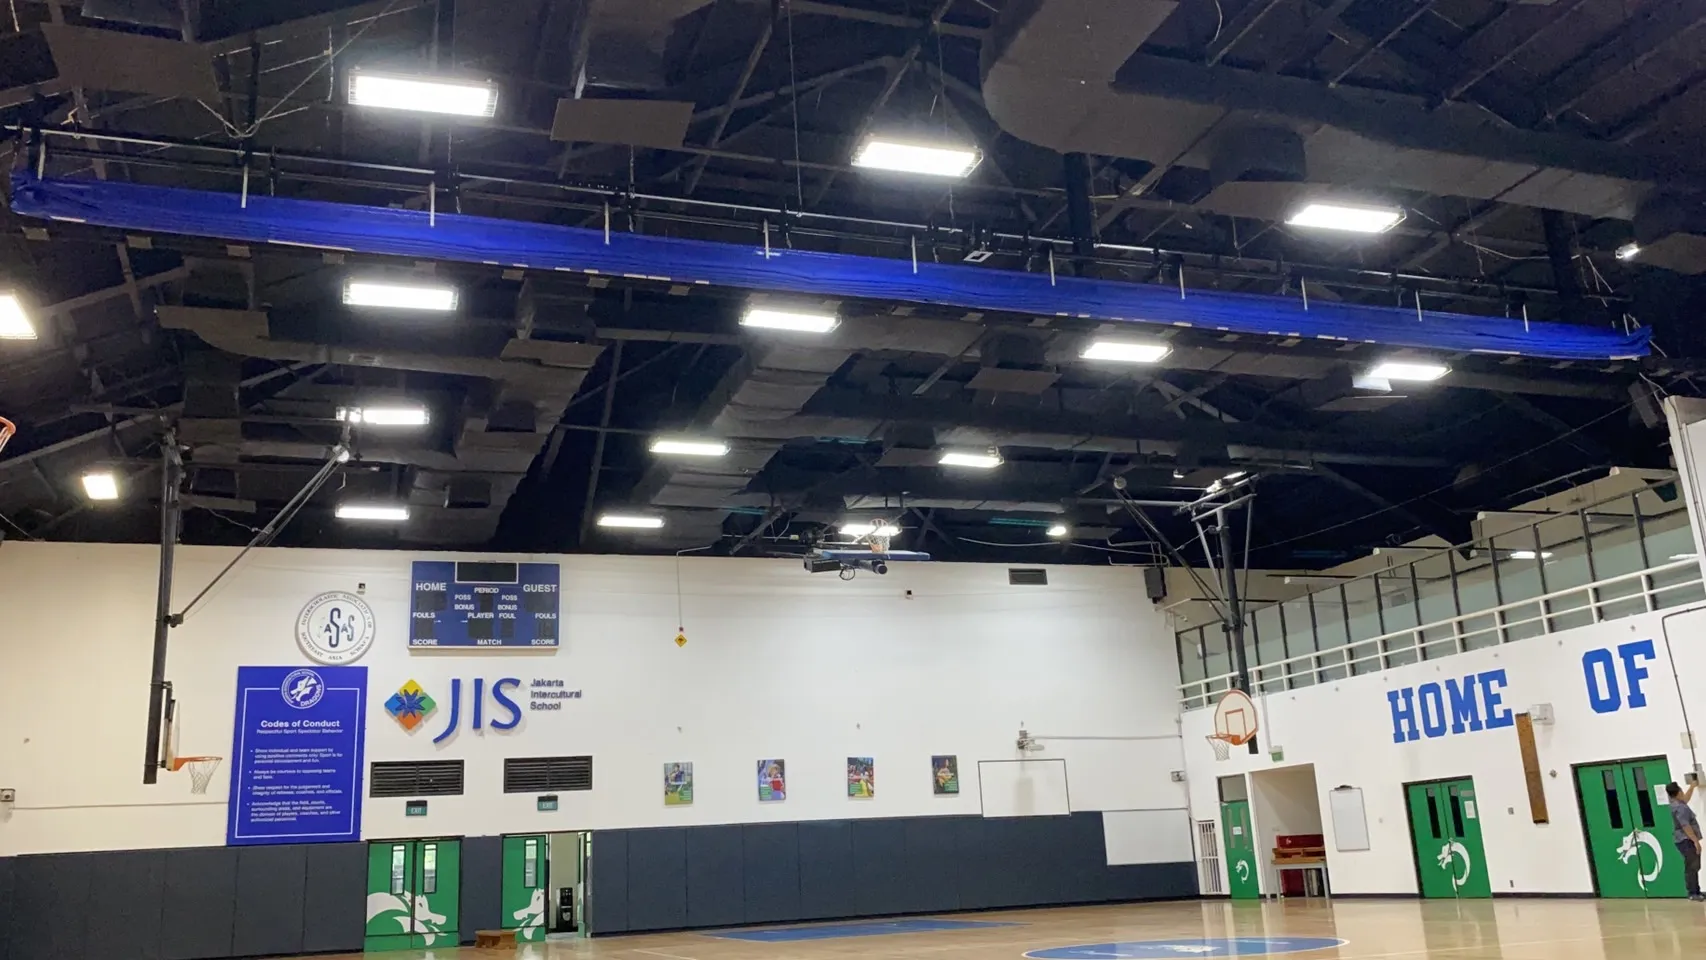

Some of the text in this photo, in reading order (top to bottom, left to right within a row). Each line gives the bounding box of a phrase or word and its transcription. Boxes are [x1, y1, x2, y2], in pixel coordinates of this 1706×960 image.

[416, 582, 446, 591] HOME
[523, 584, 557, 592] GUEST
[530, 678, 564, 687] Jakarta
[300, 684, 322, 706] DRAGONS
[530, 690, 582, 699] Intercultural
[1386, 639, 1656, 744] HOME OF
[530, 702, 561, 710] School
[432, 678, 522, 744] JIS
